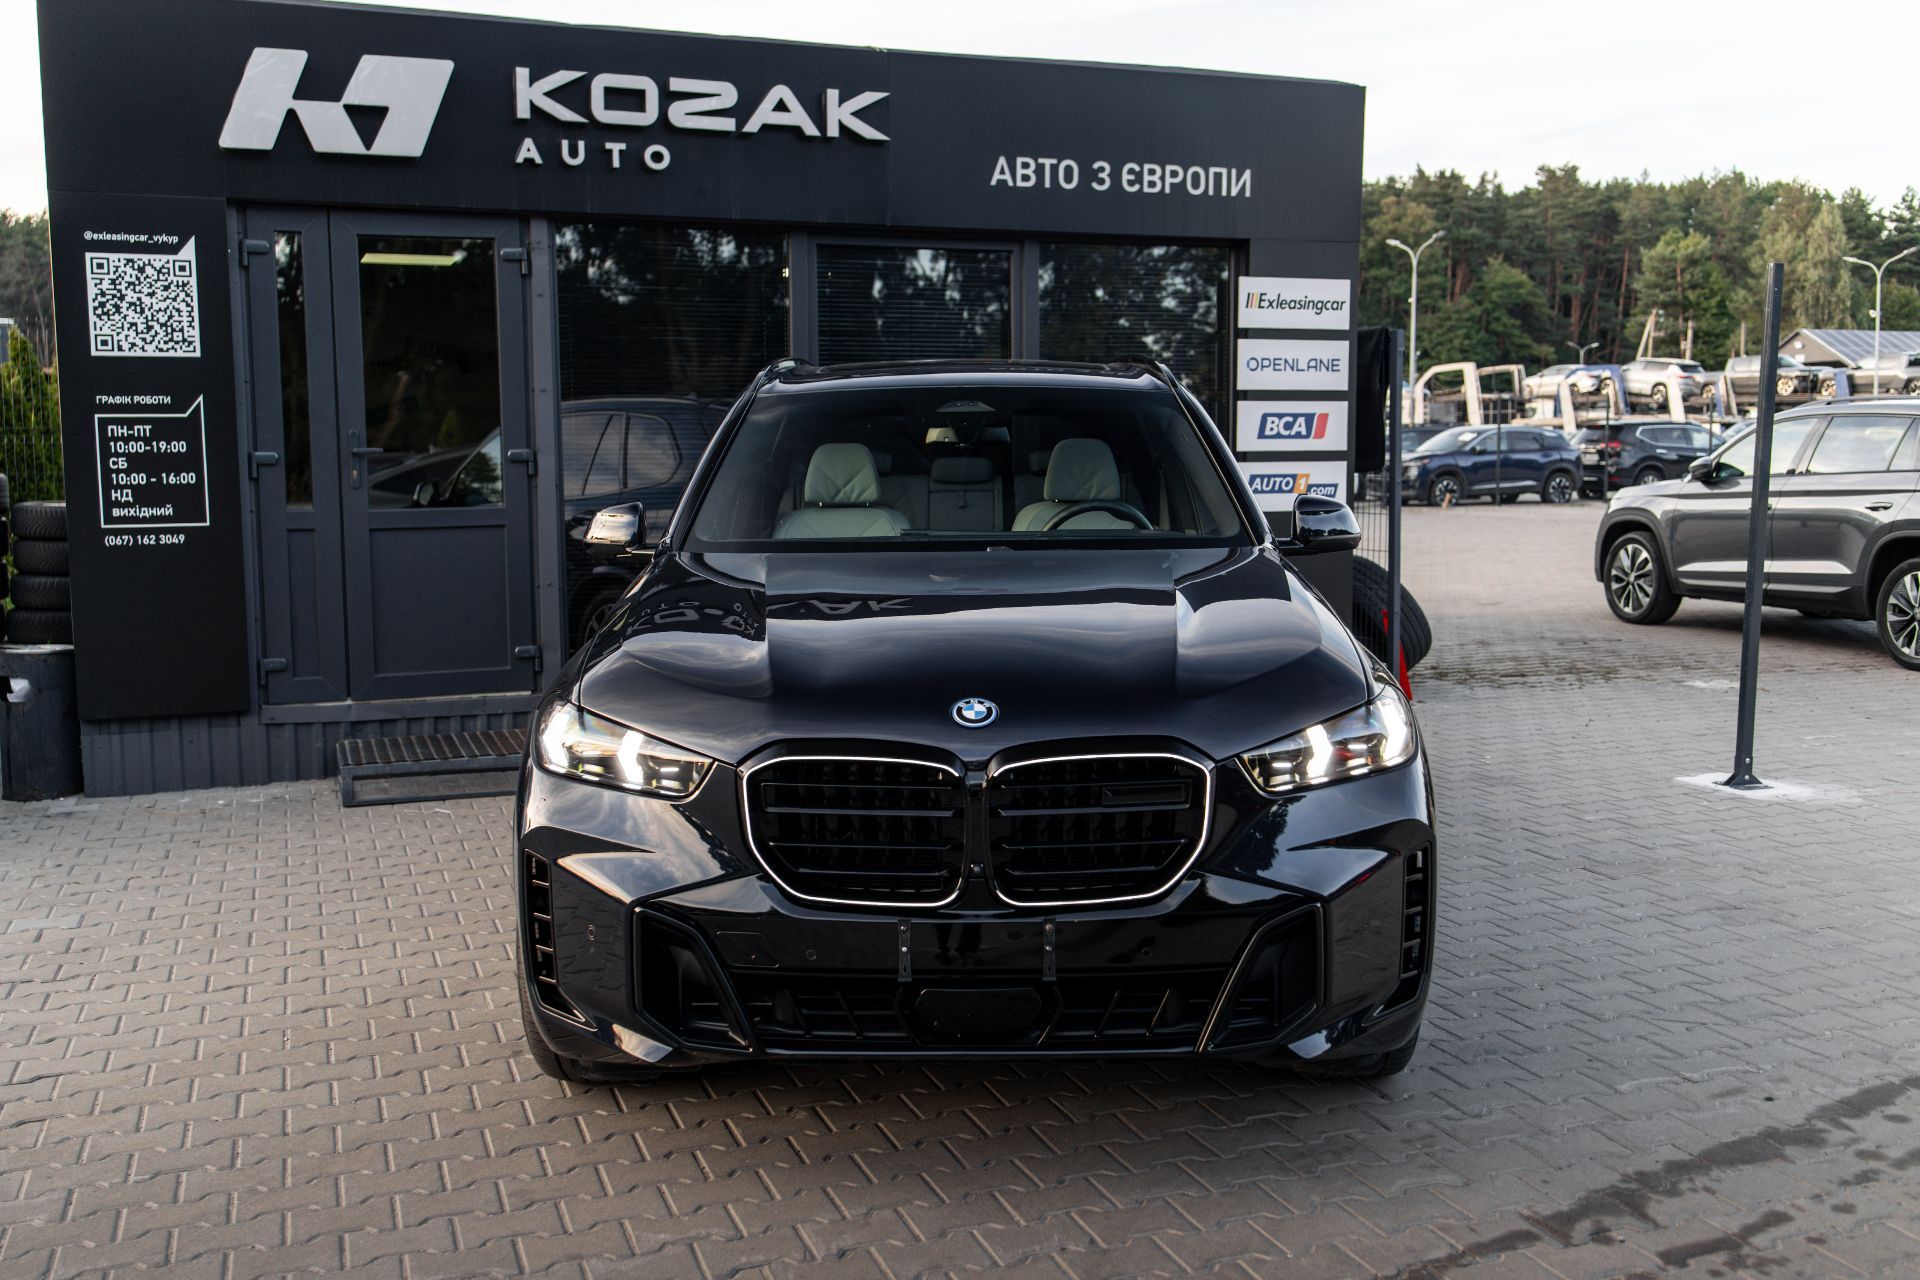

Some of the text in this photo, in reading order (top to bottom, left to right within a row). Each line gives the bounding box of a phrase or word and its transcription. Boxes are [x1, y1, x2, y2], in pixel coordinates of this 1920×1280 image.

[513, 66, 892, 142] KOZAK
[514, 137, 672, 171] AUTO
[989, 155, 1079, 190] АВТО
[1121, 162, 1252, 198] ЄВРОПИ
[83, 230, 179, 244] @exleasingcar_vykyp
[1257, 292, 1346, 315] Exleasingcar
[1246, 356, 1342, 373] OPENLANE
[96, 395, 172, 405] ГРАФІК РОБОТИ
[107, 425, 152, 438] ПН-ПТ
[1264, 416, 1308, 437] BCA
[109, 441, 187, 454] 10:00-19:00
[109, 457, 128, 470] СБ
[111, 473, 147, 486] 10:00
[161, 472, 197, 485] 16:00
[111, 489, 134, 503] НД
[112, 503, 174, 518] вихідний
[104, 533, 186, 547] (067) 162 3049
